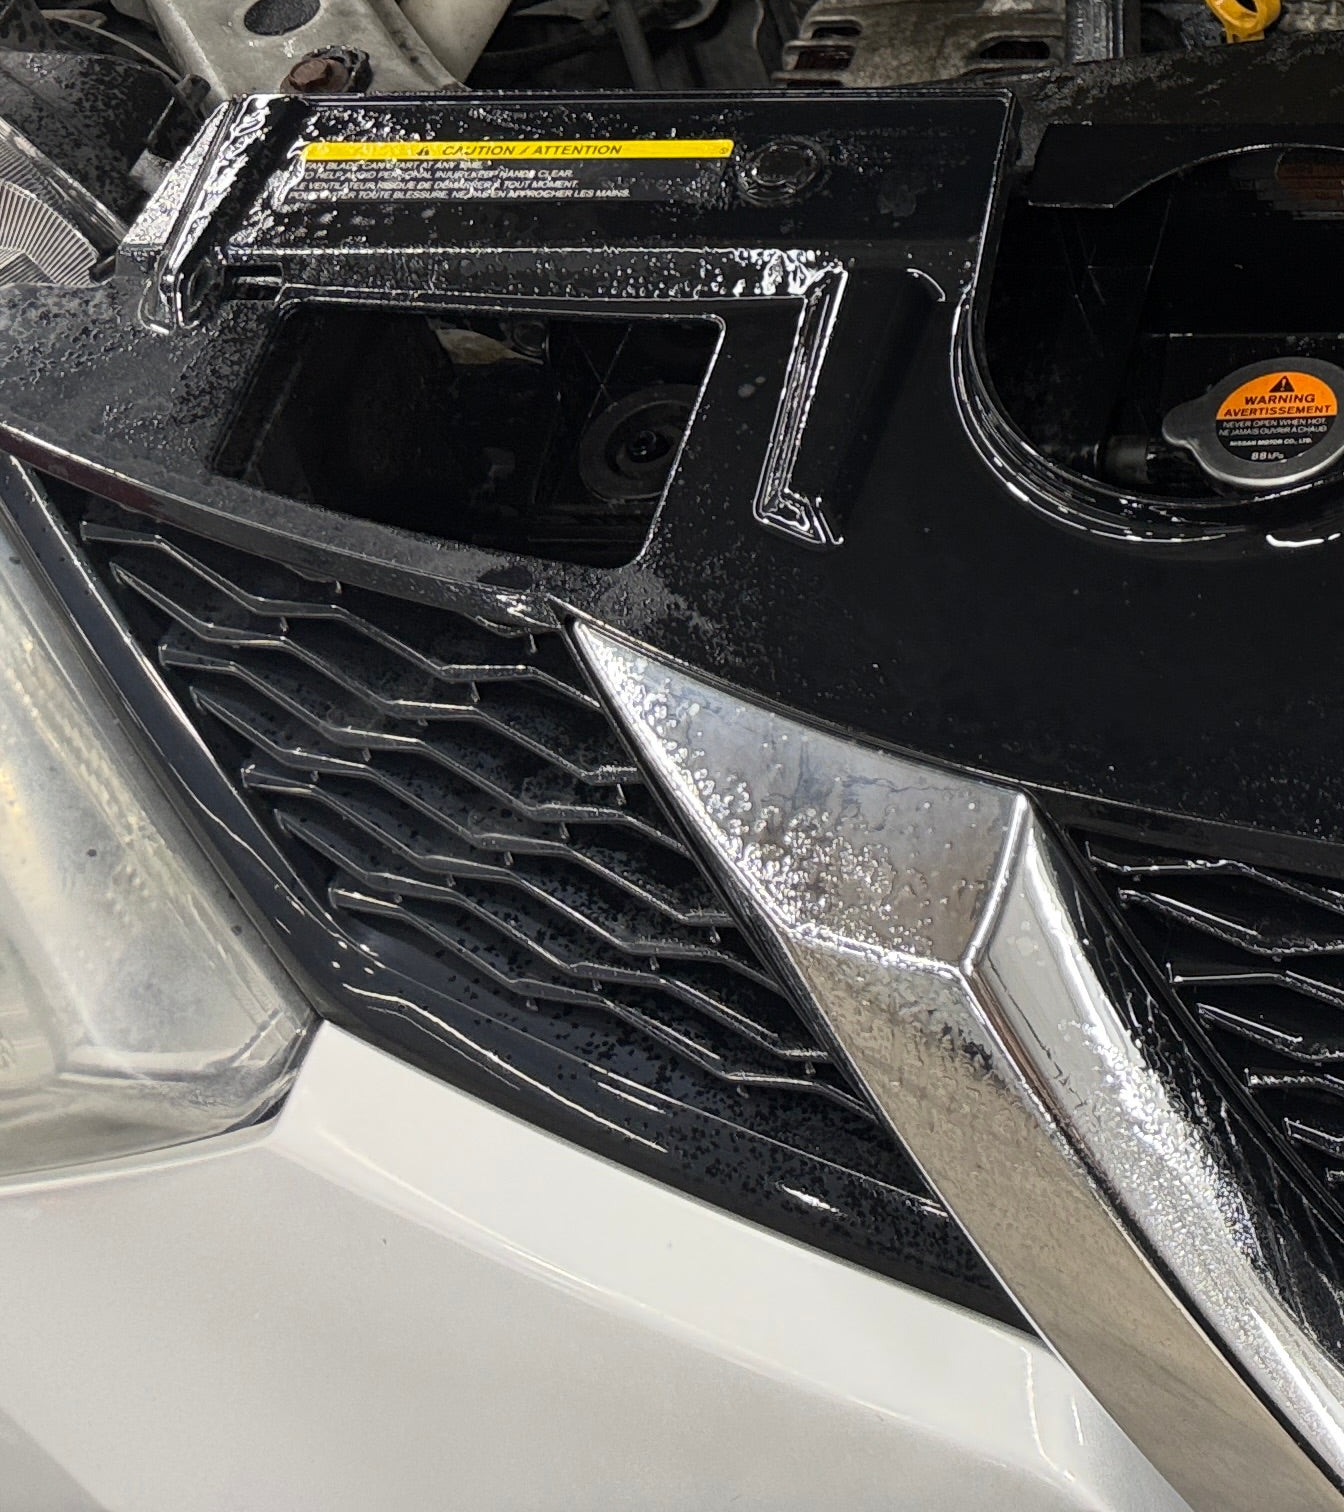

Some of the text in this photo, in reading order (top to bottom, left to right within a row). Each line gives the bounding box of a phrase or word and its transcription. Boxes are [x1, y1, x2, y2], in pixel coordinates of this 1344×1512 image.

[442, 145, 516, 156] CAUTION
[531, 144, 622, 155] ATTENTION
[305, 161, 326, 170] FAN
[326, 161, 361, 170] BLADE
[361, 161, 386, 169] CAN
[420, 160, 434, 169] AT
[434, 160, 457, 169] ANY
[309, 180, 376, 190] VENTILATEUR
[416, 180, 434, 190] DE
[502, 179, 530, 189] TOUT
[358, 190, 392, 199] TOUTE
[506, 189, 573, 199] APPROCHER
[573, 189, 595, 198] LES
[1244, 393, 1316, 405] WARNING
[1223, 404, 1332, 417] AVERTISSEMENT
[1223, 420, 1252, 429] NEVER
[1253, 419, 1278, 428] OPEN
[1280, 418, 1307, 427] WHEN
[1218, 429, 1231, 437] NE
[1230, 427, 1259, 436] JAMAIS
[1229, 438, 1257, 447] NISSAN
[1251, 451, 1266, 461] 88
